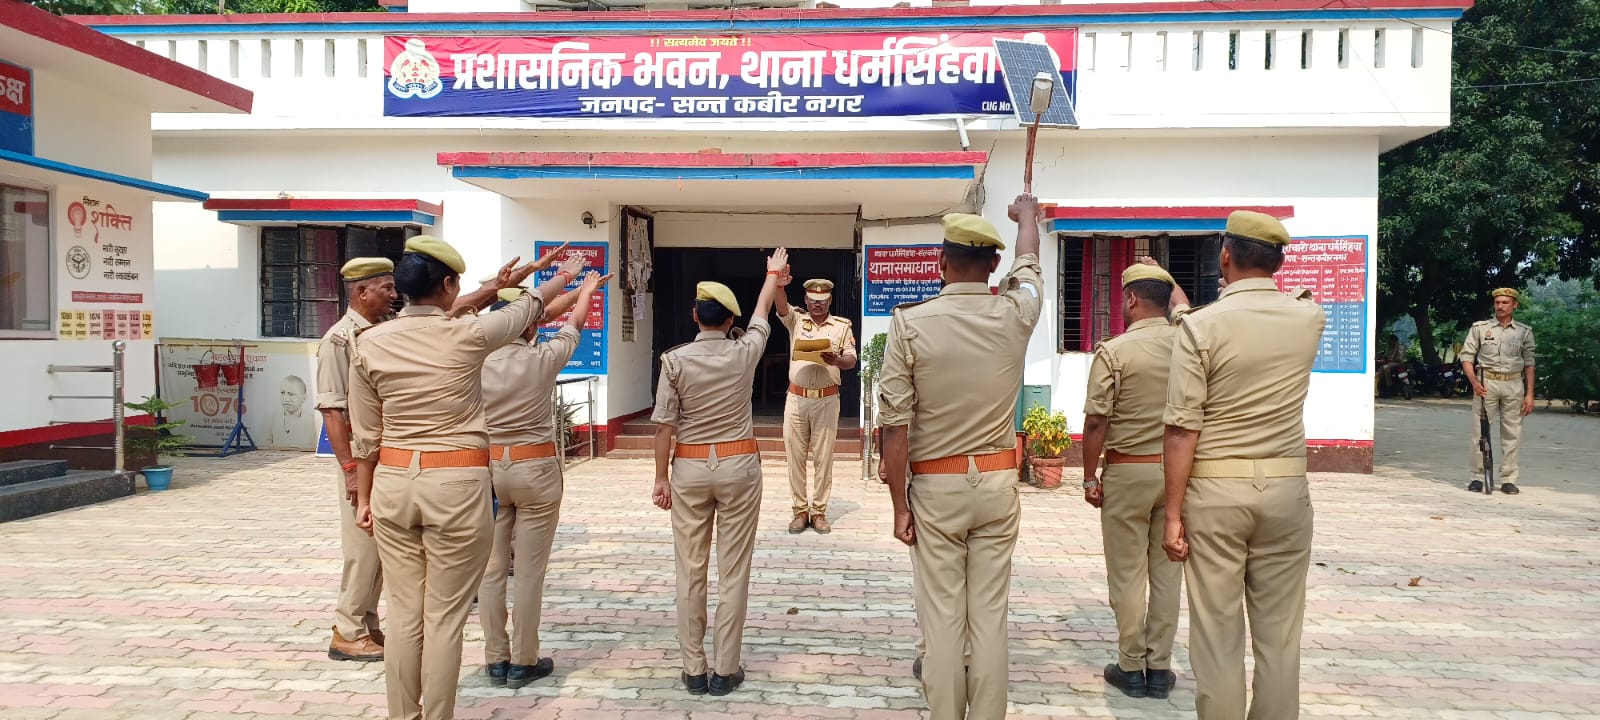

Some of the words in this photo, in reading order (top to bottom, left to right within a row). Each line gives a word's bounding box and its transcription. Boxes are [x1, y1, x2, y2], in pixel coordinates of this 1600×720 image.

[663, 36, 707, 47] सत्यमेव
[709, 36, 738, 47] जयते
[450, 41, 626, 90] प्रशासनिक
[633, 51, 729, 90] भवन,
[741, 50, 827, 88] थाना
[832, 34, 998, 88] धर्मसिंहवा
[671, 95, 727, 114] सन्त
[734, 91, 801, 113] कबीर
[804, 93, 864, 113] नगर
[982, 101, 998, 111] CUG
